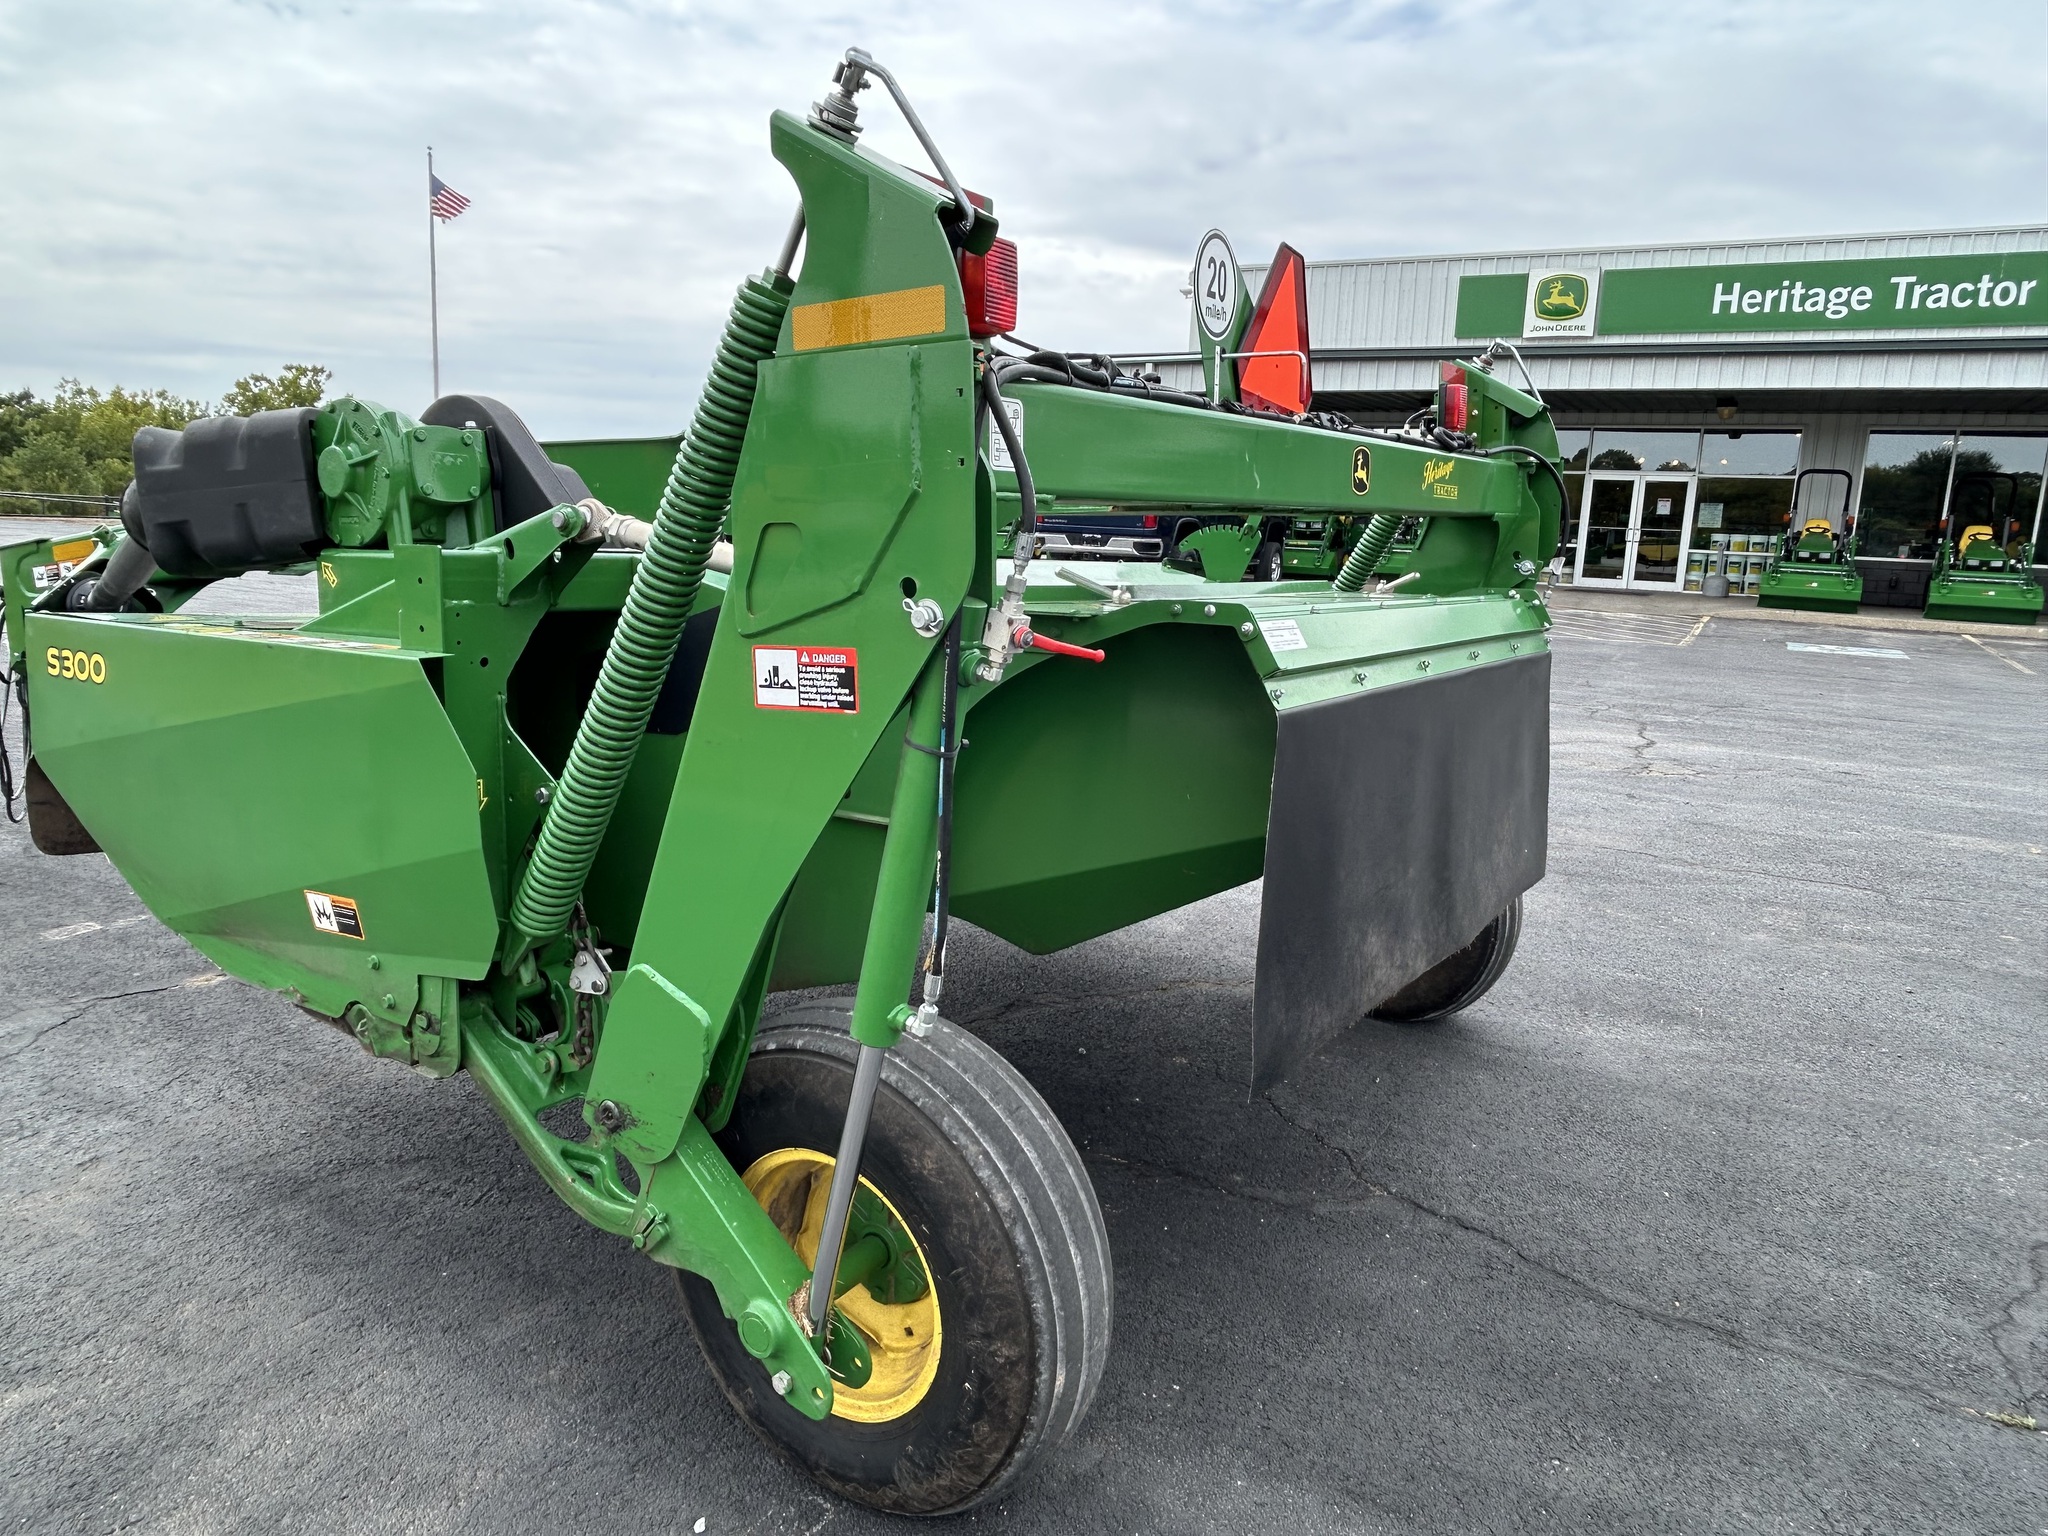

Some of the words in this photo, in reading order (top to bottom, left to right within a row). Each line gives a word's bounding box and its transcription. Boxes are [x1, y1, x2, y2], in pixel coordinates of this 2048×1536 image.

[1206, 256, 1227, 303] 20
[1711, 278, 1873, 319] Heritage
[1890, 274, 2037, 311] Tractor
[1205, 304, 1227, 322] mile/h
[46, 646, 107, 684] S300
[812, 654, 846, 664] DANGER
